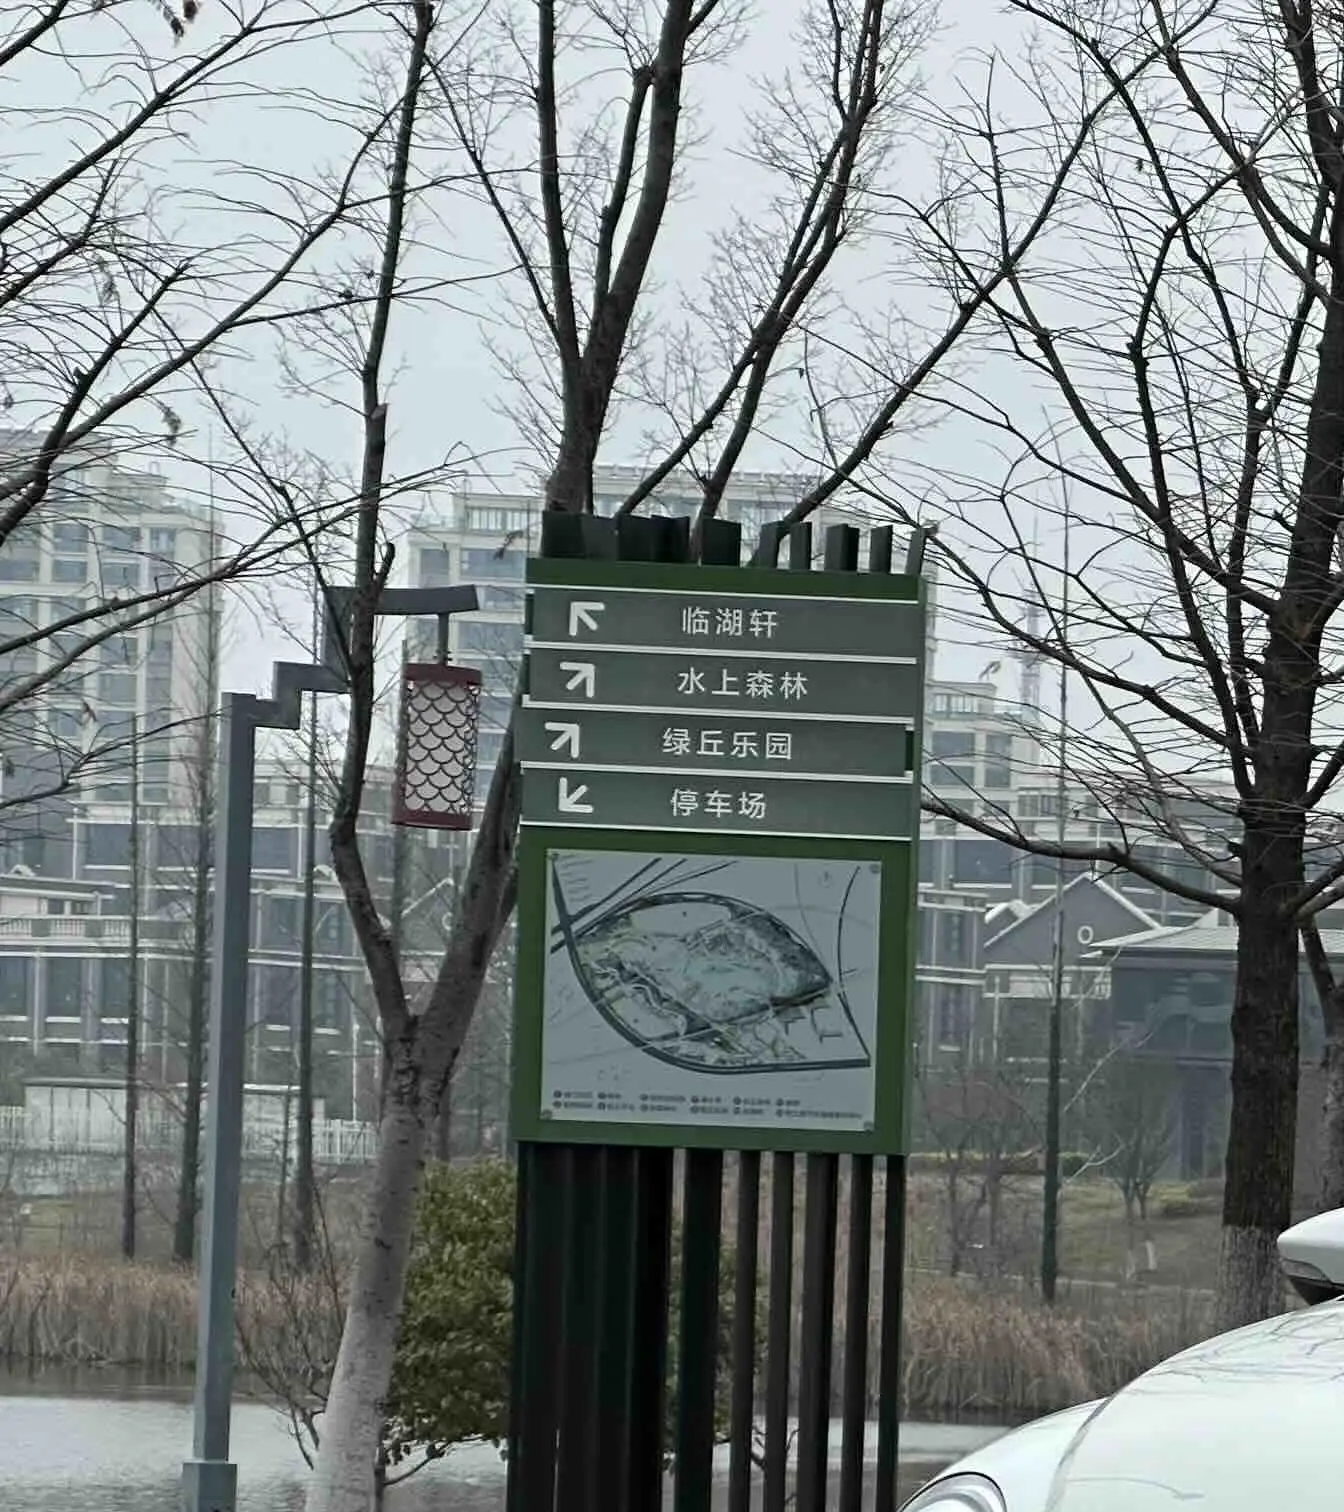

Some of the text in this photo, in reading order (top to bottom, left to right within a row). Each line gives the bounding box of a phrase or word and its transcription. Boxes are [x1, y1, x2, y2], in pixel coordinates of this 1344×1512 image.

[681, 606, 778, 639] 临湖轩
[677, 667, 809, 700] 水上森林
[662, 727, 793, 761] 绿丘乐园
[670, 788, 767, 820] 停车场
